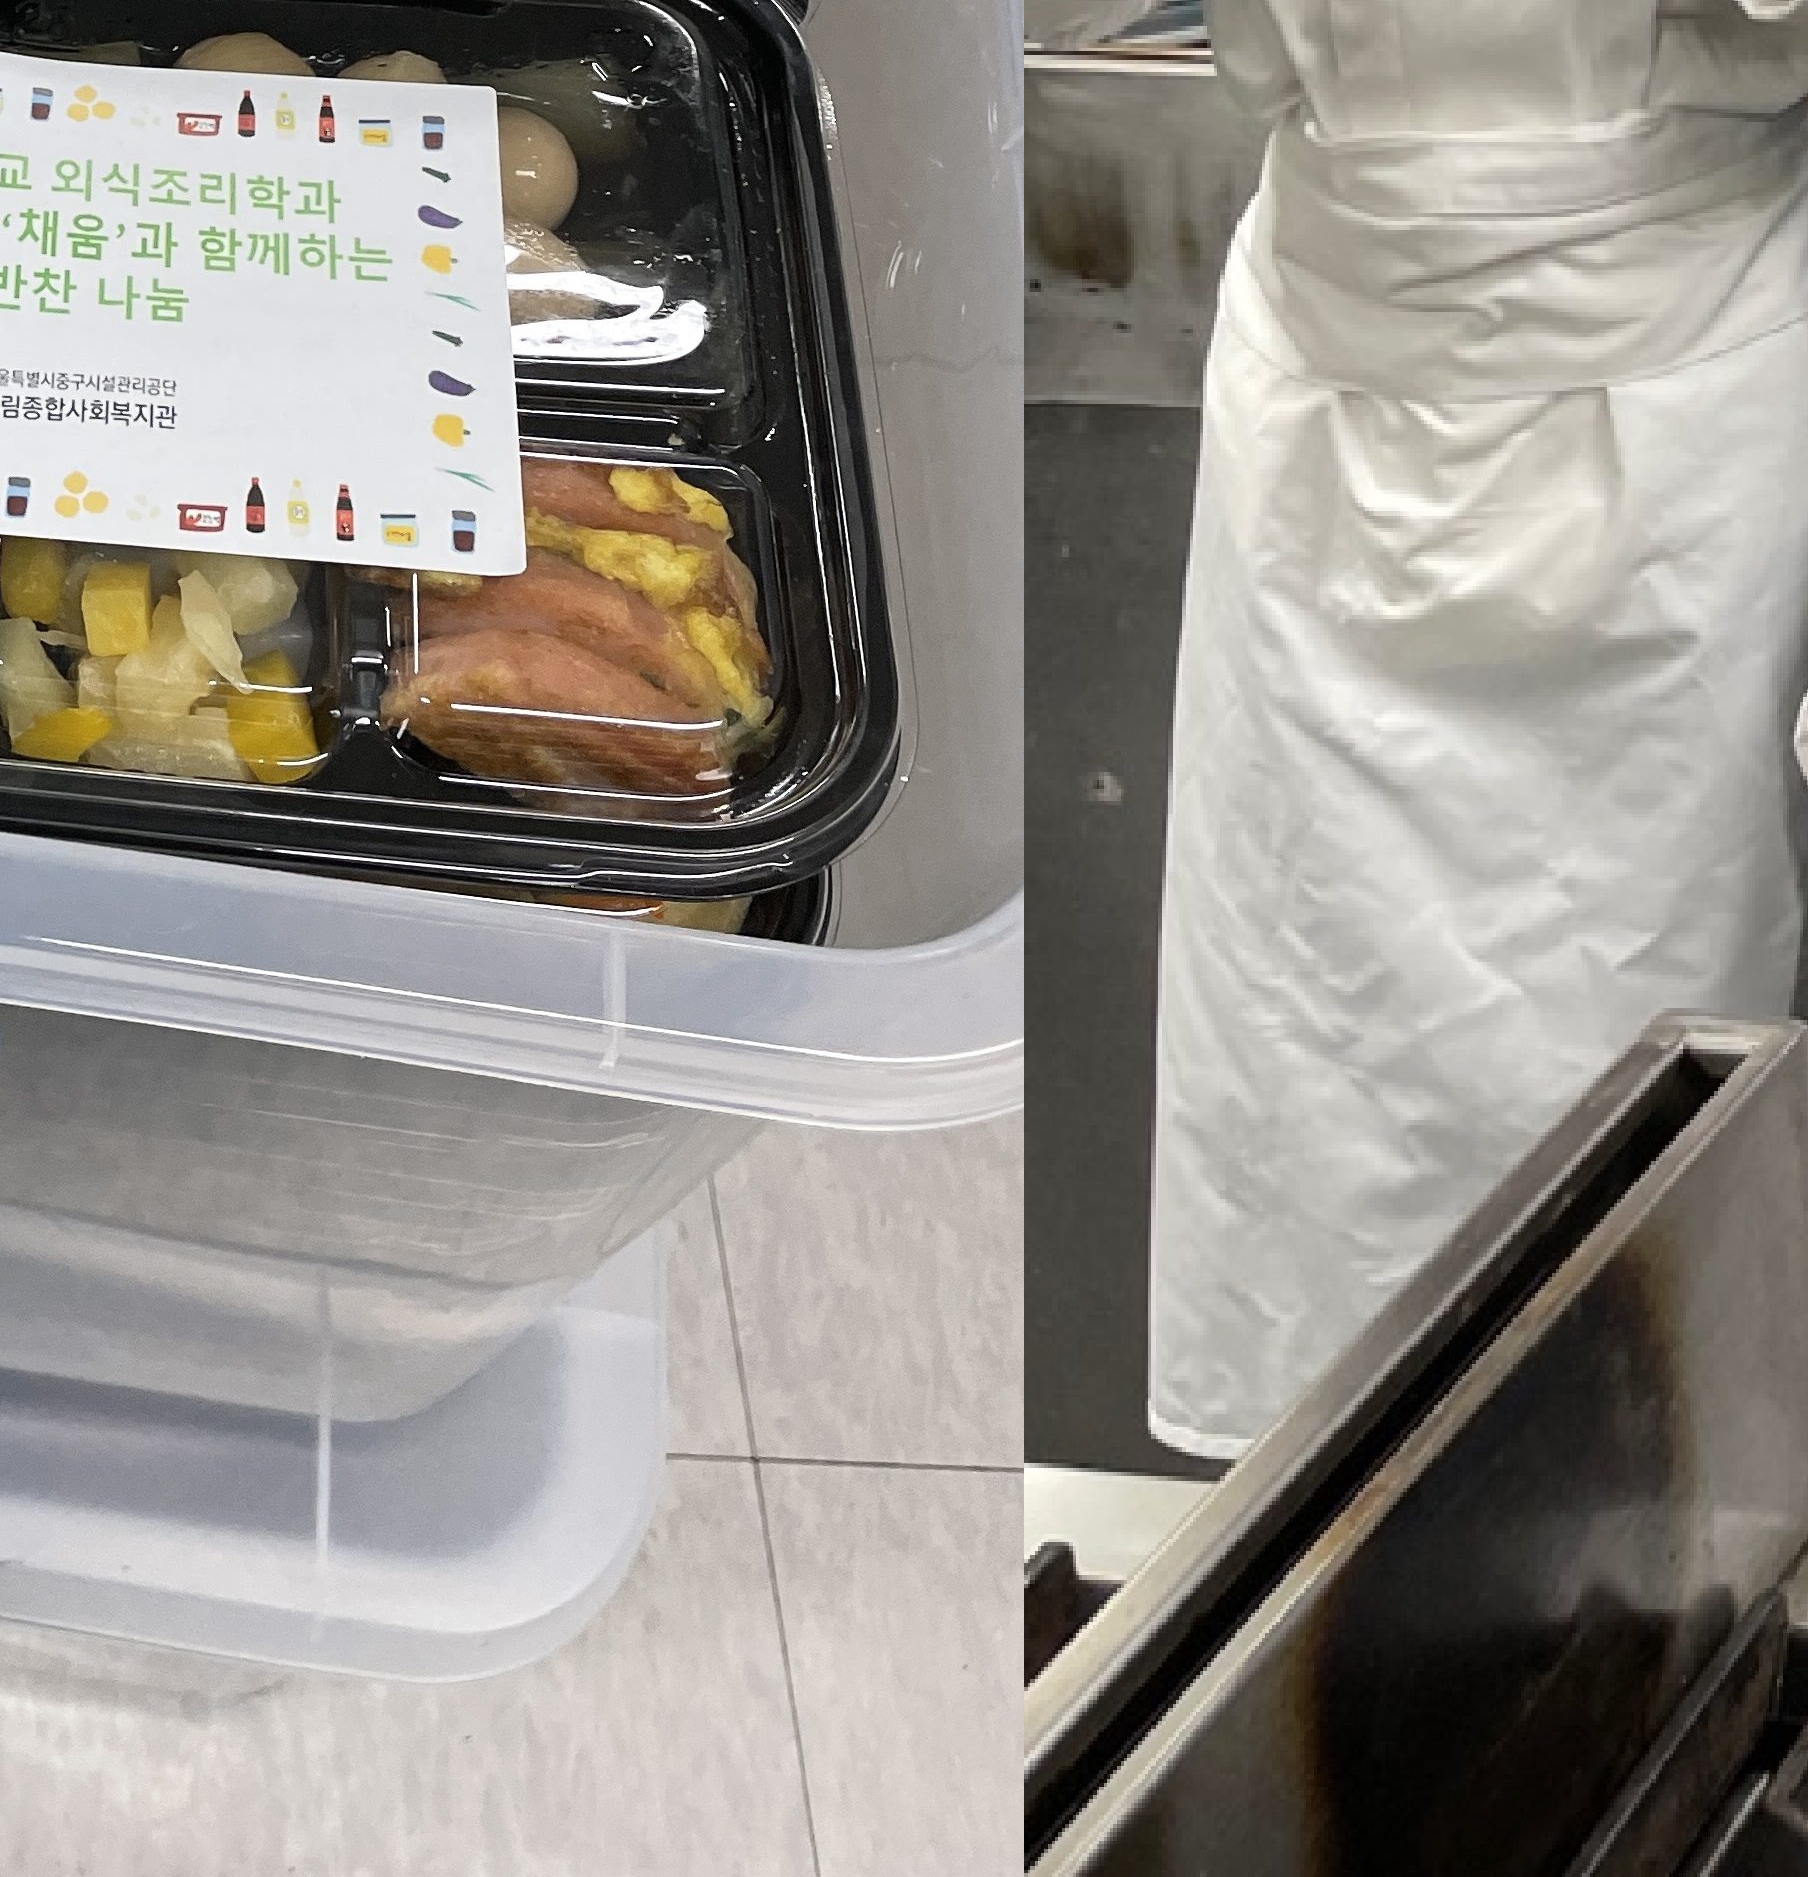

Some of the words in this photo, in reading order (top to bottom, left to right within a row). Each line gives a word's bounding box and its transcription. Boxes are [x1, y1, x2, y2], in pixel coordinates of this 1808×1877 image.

[50, 158, 342, 224] 외식조리학과
[197, 224, 393, 282] 함께하는
[96, 274, 190, 323] 나눔
